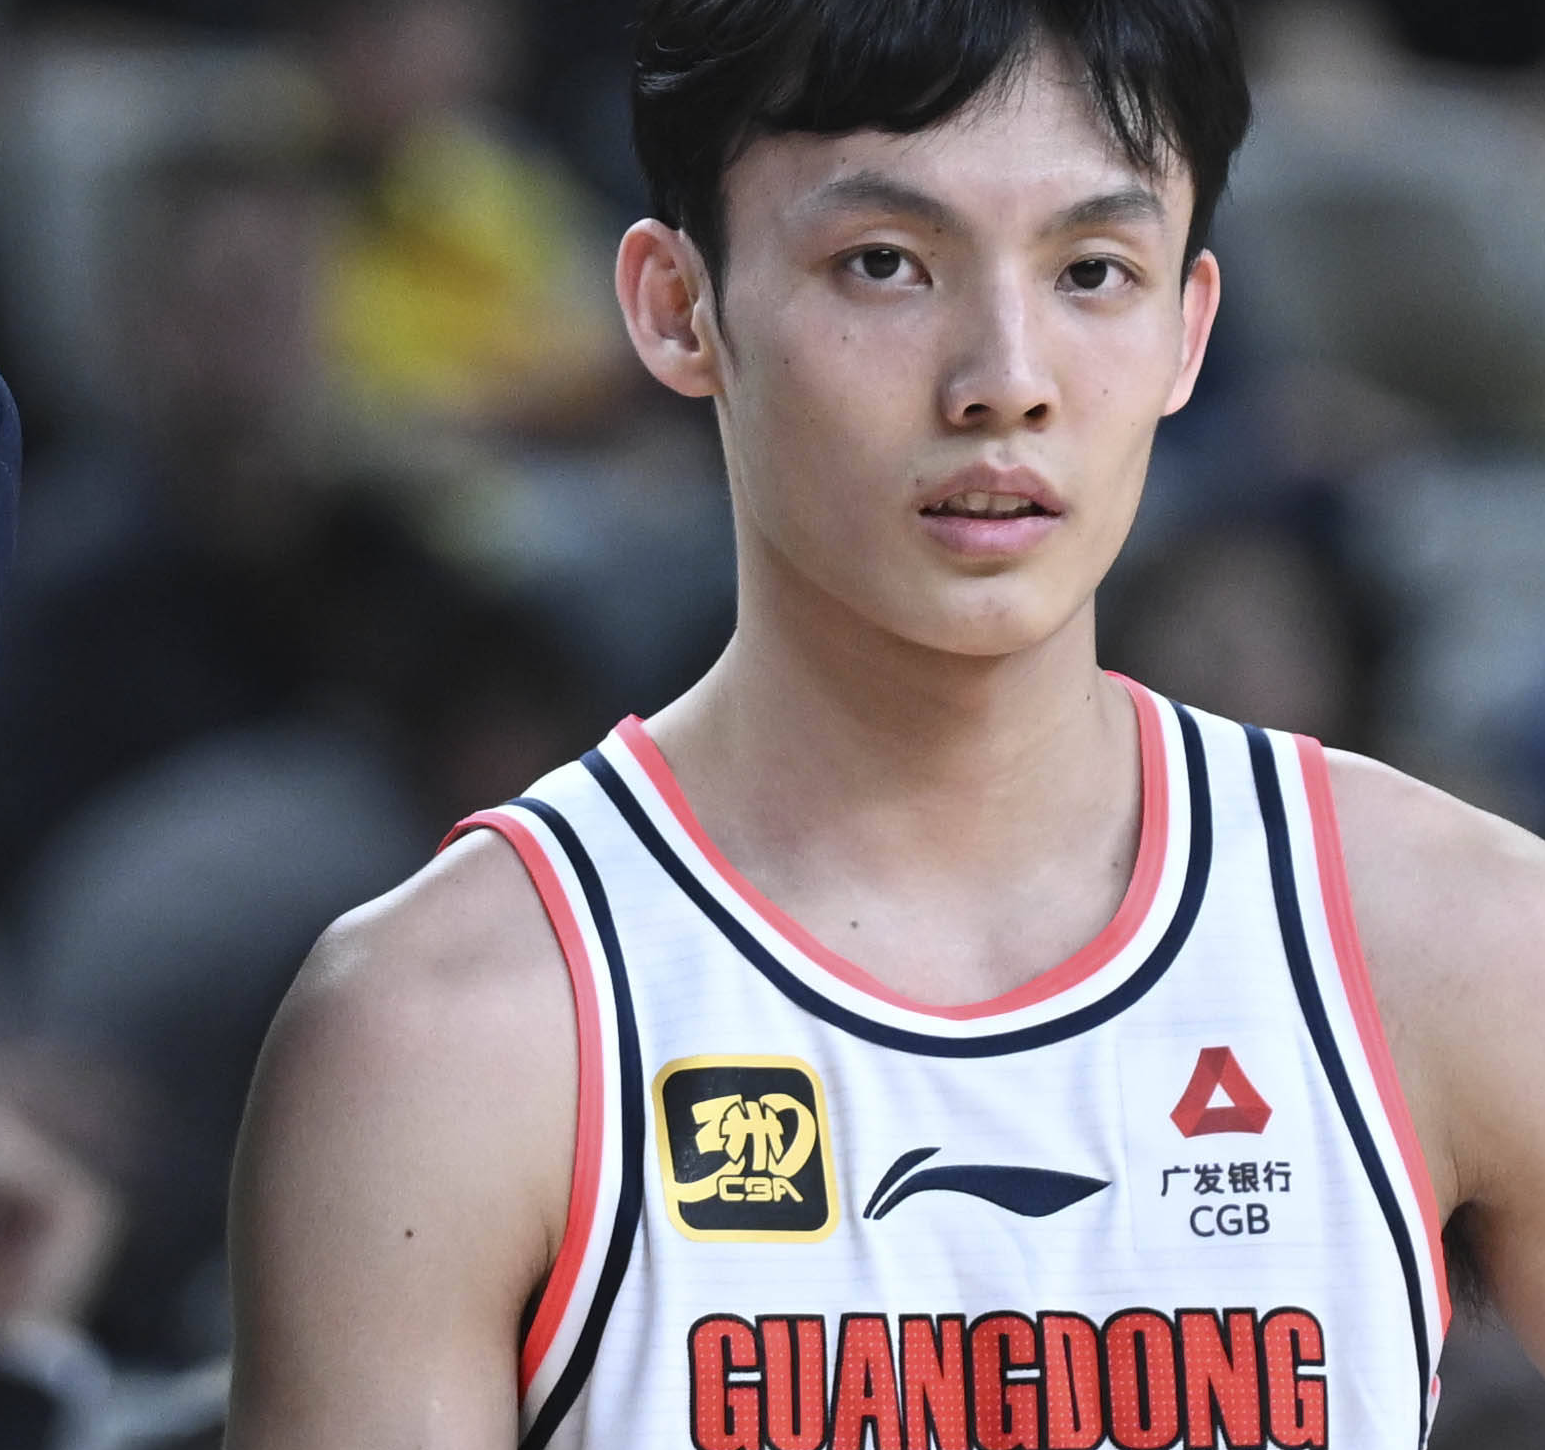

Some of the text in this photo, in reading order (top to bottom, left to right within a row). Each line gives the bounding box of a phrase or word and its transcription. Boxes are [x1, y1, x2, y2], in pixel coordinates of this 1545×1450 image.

[718, 1175, 804, 1203] CBA
[1160, 1161, 1292, 1197] 广发银行
[1189, 1203, 1271, 1238] CGB
